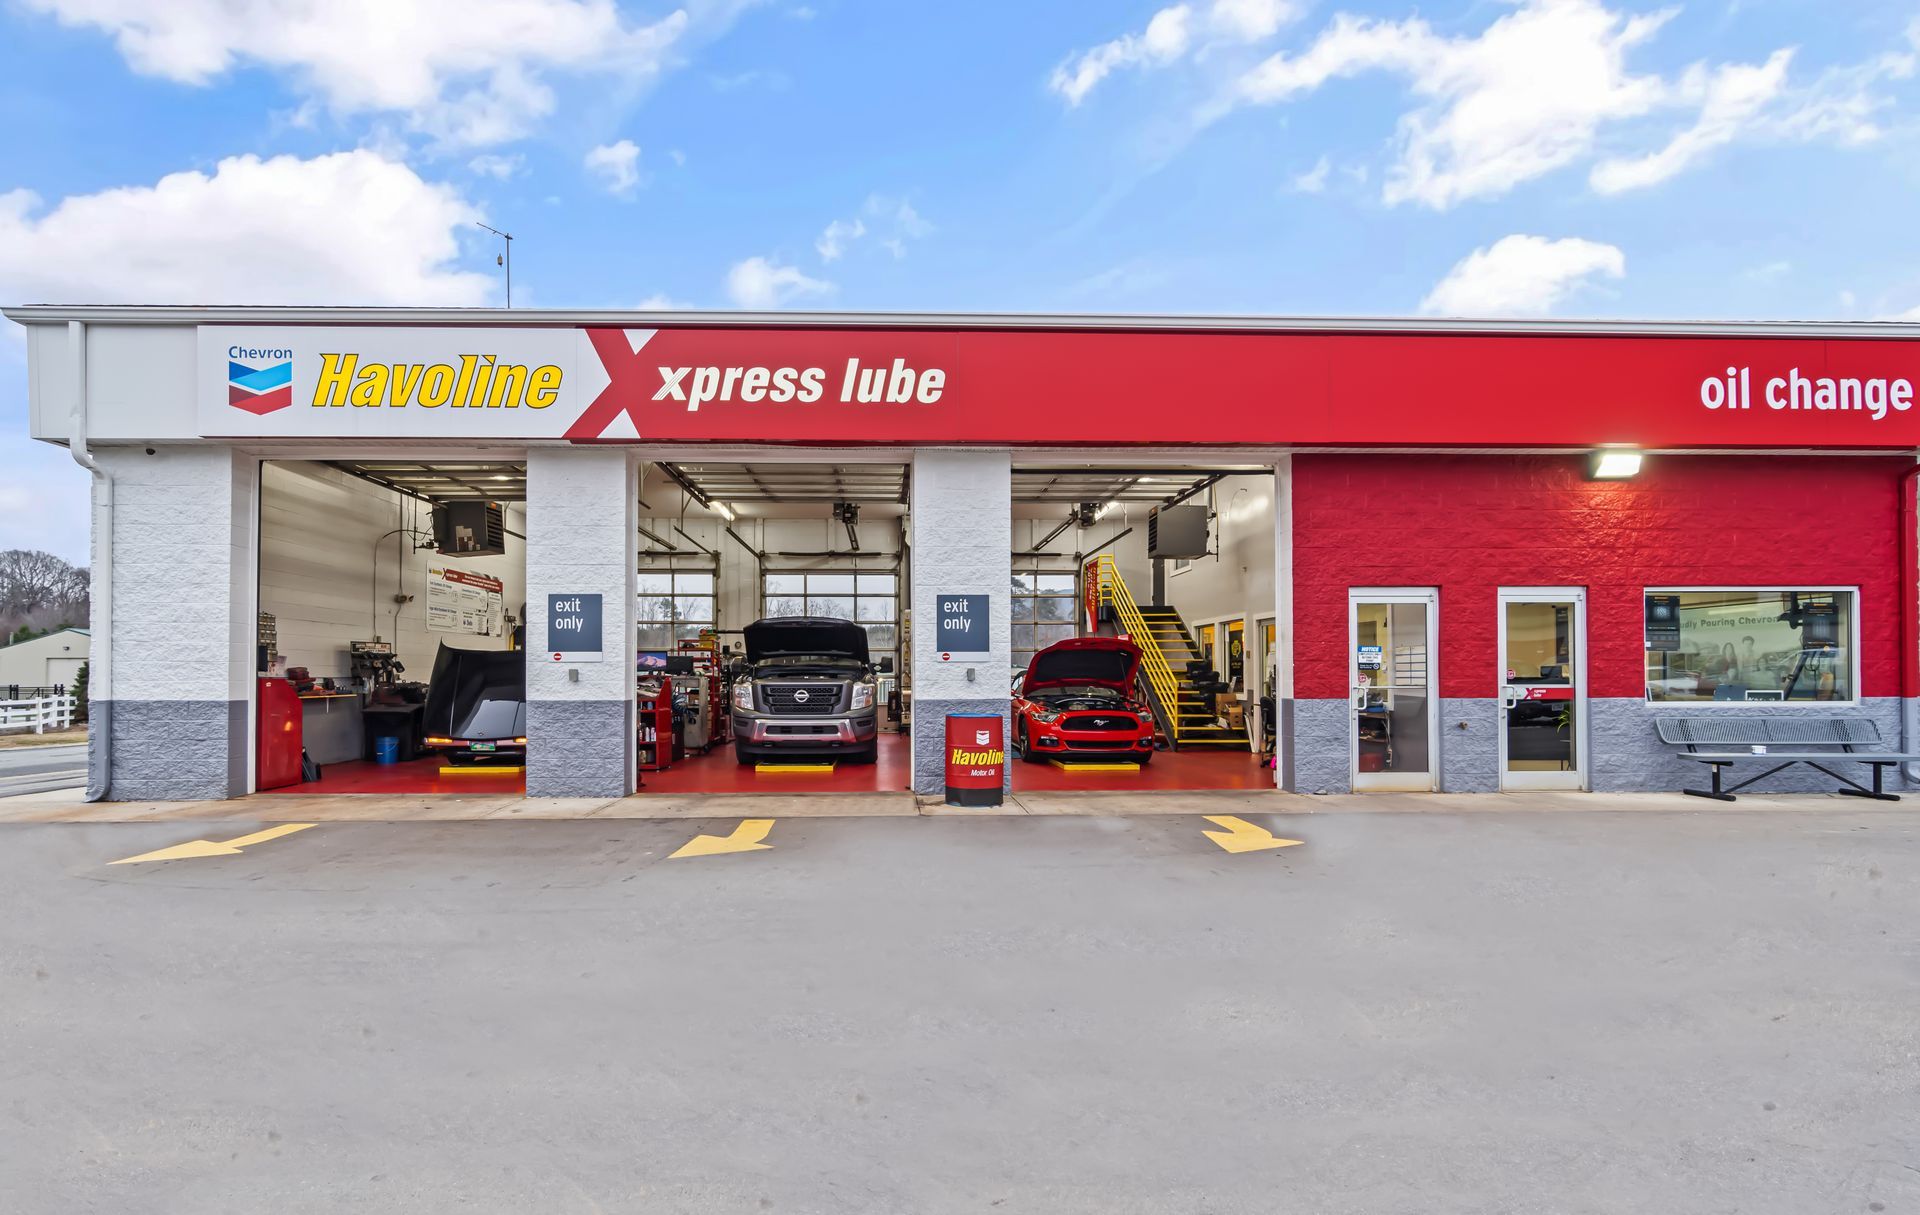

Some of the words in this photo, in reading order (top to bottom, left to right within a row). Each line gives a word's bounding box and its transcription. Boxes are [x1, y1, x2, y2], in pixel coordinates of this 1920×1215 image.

[228, 346, 292, 359] Chevron
[312, 353, 563, 409] Havoline
[651, 366, 826, 412] xpress
[840, 358, 946, 404] lube
[1700, 366, 1750, 410] oil
[1765, 367, 1914, 421] change
[555, 598, 581, 612] exit
[943, 598, 969, 612] exit
[555, 615, 584, 632] only
[943, 616, 971, 632] only
[1680, 621, 1697, 629] udly
[1701, 618, 1735, 627] Pouring
[970, 769, 987, 777] Motor
